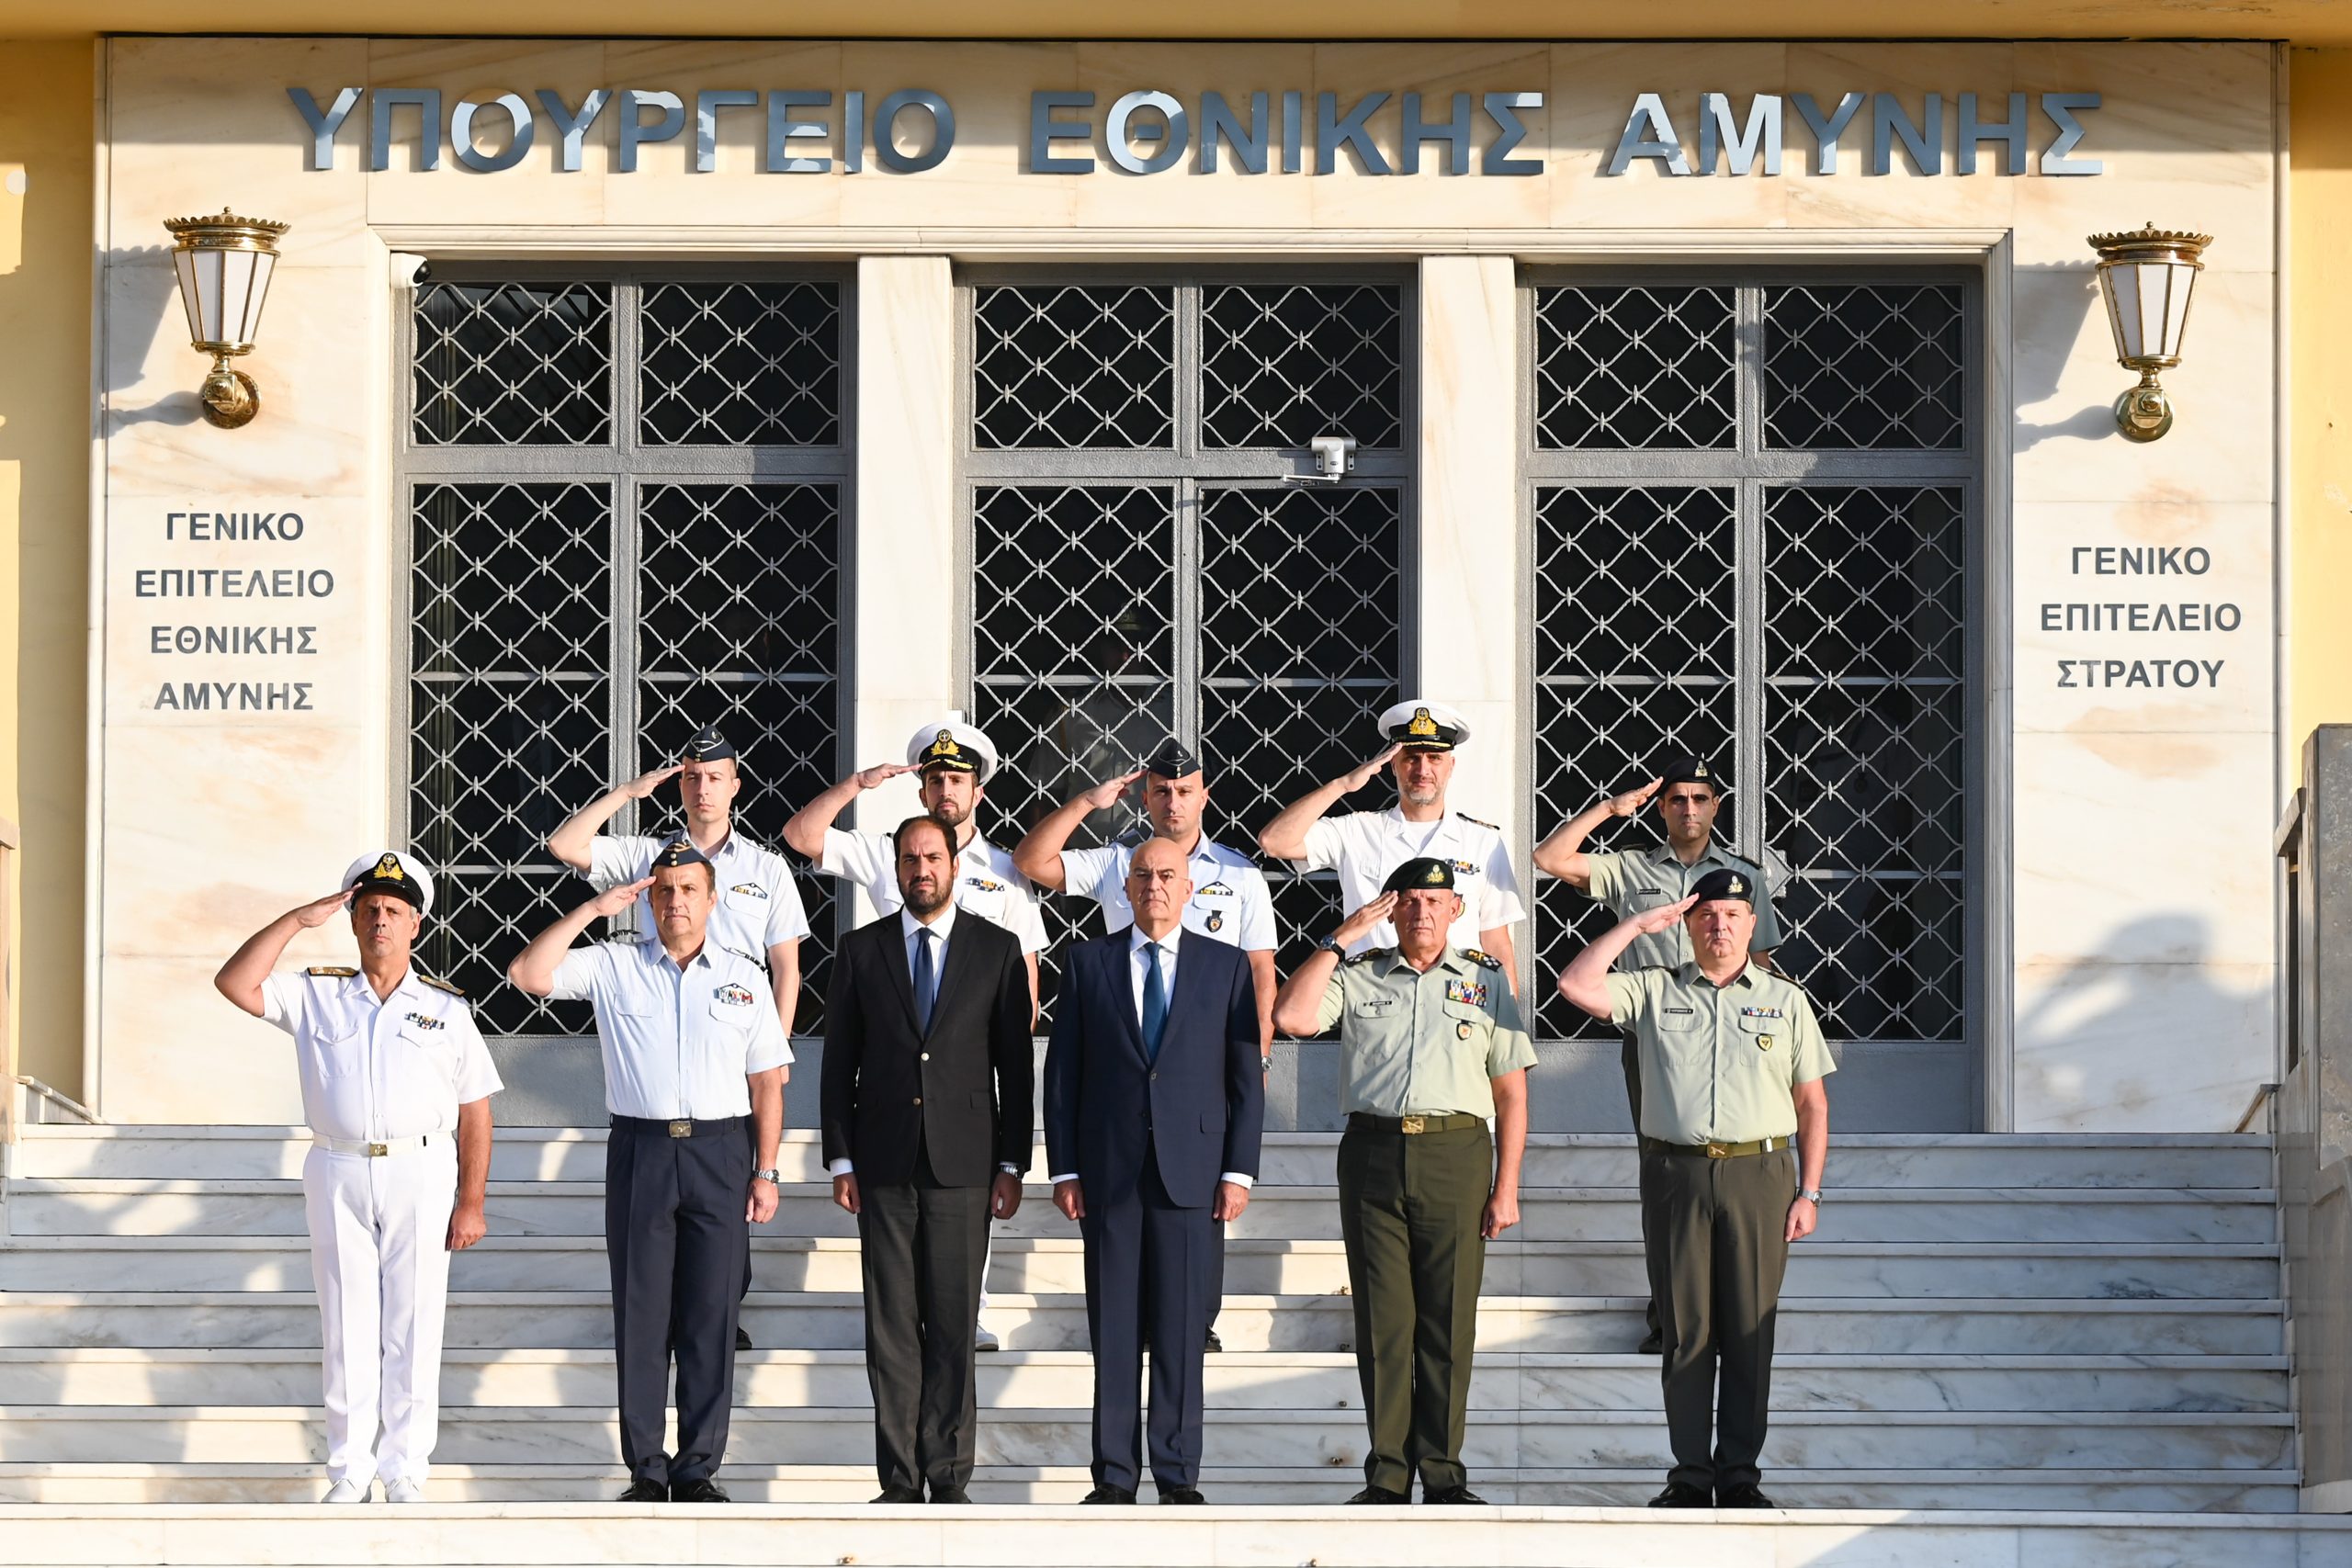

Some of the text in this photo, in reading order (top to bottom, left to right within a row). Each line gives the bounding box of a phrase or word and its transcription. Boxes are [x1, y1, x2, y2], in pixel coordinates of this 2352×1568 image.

[286, 87, 2104, 177] ΥΠΟΥΡΓΕΙΟ ΕΘΝΙΚΗΣ ΑΜΥΝΗΣ
[166, 513, 304, 541] ΓΕΝΙΚΟ
[2072, 547, 2211, 575] ΓΕΝΙΚΟ
[135, 570, 334, 598] ΕΠΙΤΕΛΕΙΟ
[2041, 604, 2241, 632] ΕΠΙΤΕΛΕΙΟ
[151, 626, 318, 654] ΕΘΝΙΚΗΣ
[2057, 660, 2225, 688] ΣΤΡΑΤΟΥ
[153, 682, 313, 710] ΑΜΥΝΗΣ
